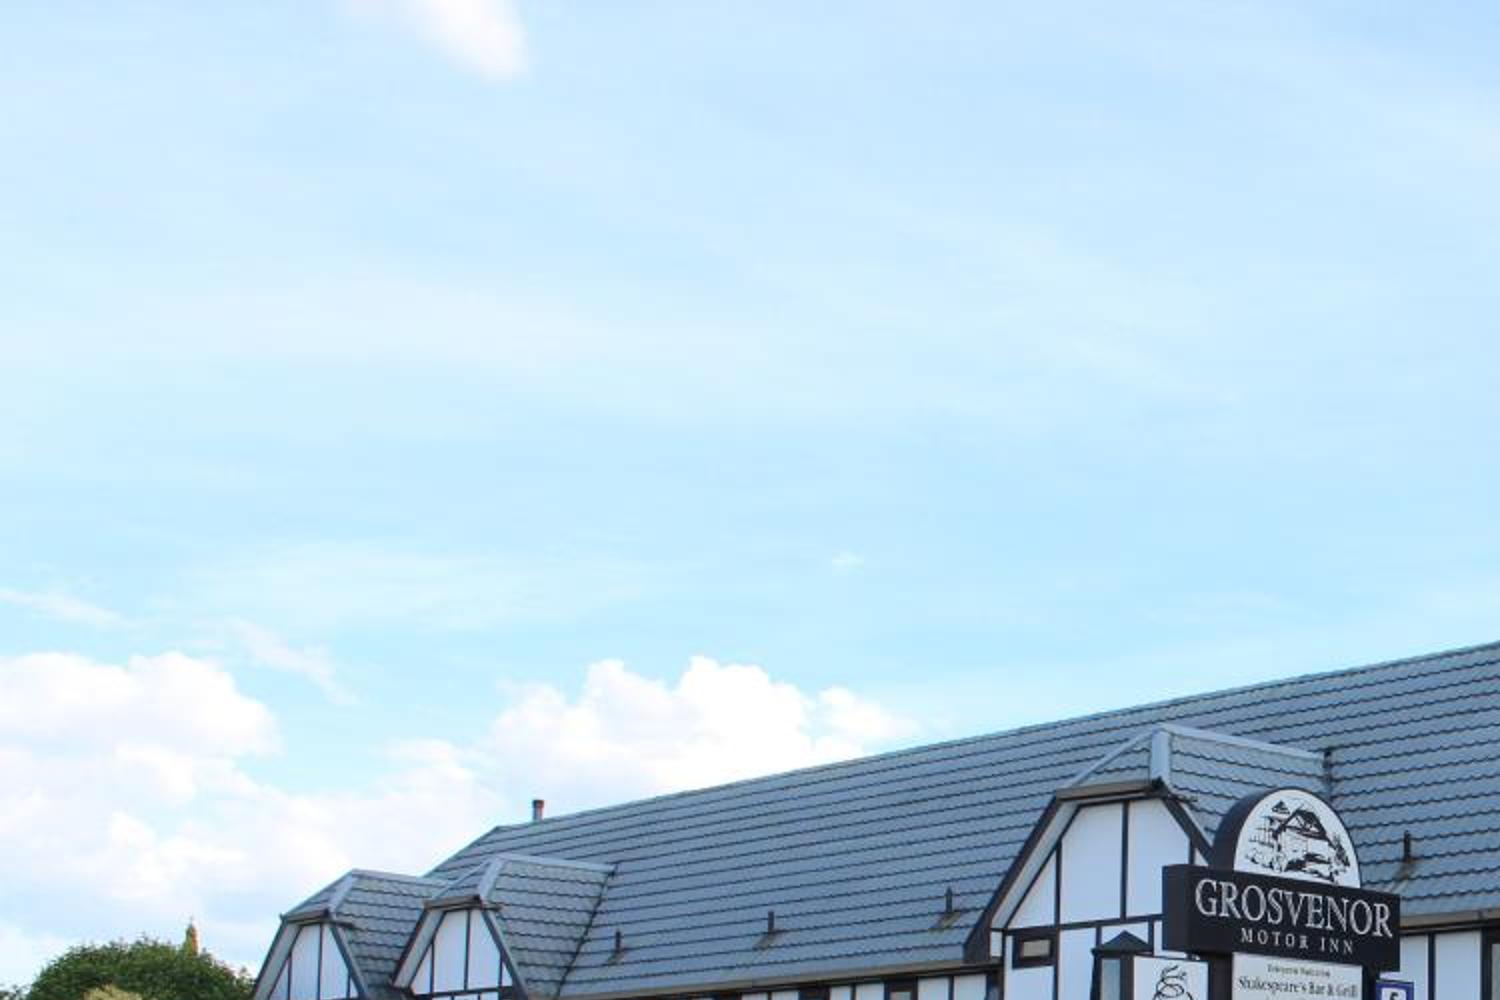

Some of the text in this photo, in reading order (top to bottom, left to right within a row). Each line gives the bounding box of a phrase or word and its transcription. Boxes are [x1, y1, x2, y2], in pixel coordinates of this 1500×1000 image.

[1195, 878, 1393, 938] GROSVENOR
[1241, 927, 1353, 955] MOTOR INN
[1308, 981, 1325, 996] Bar
